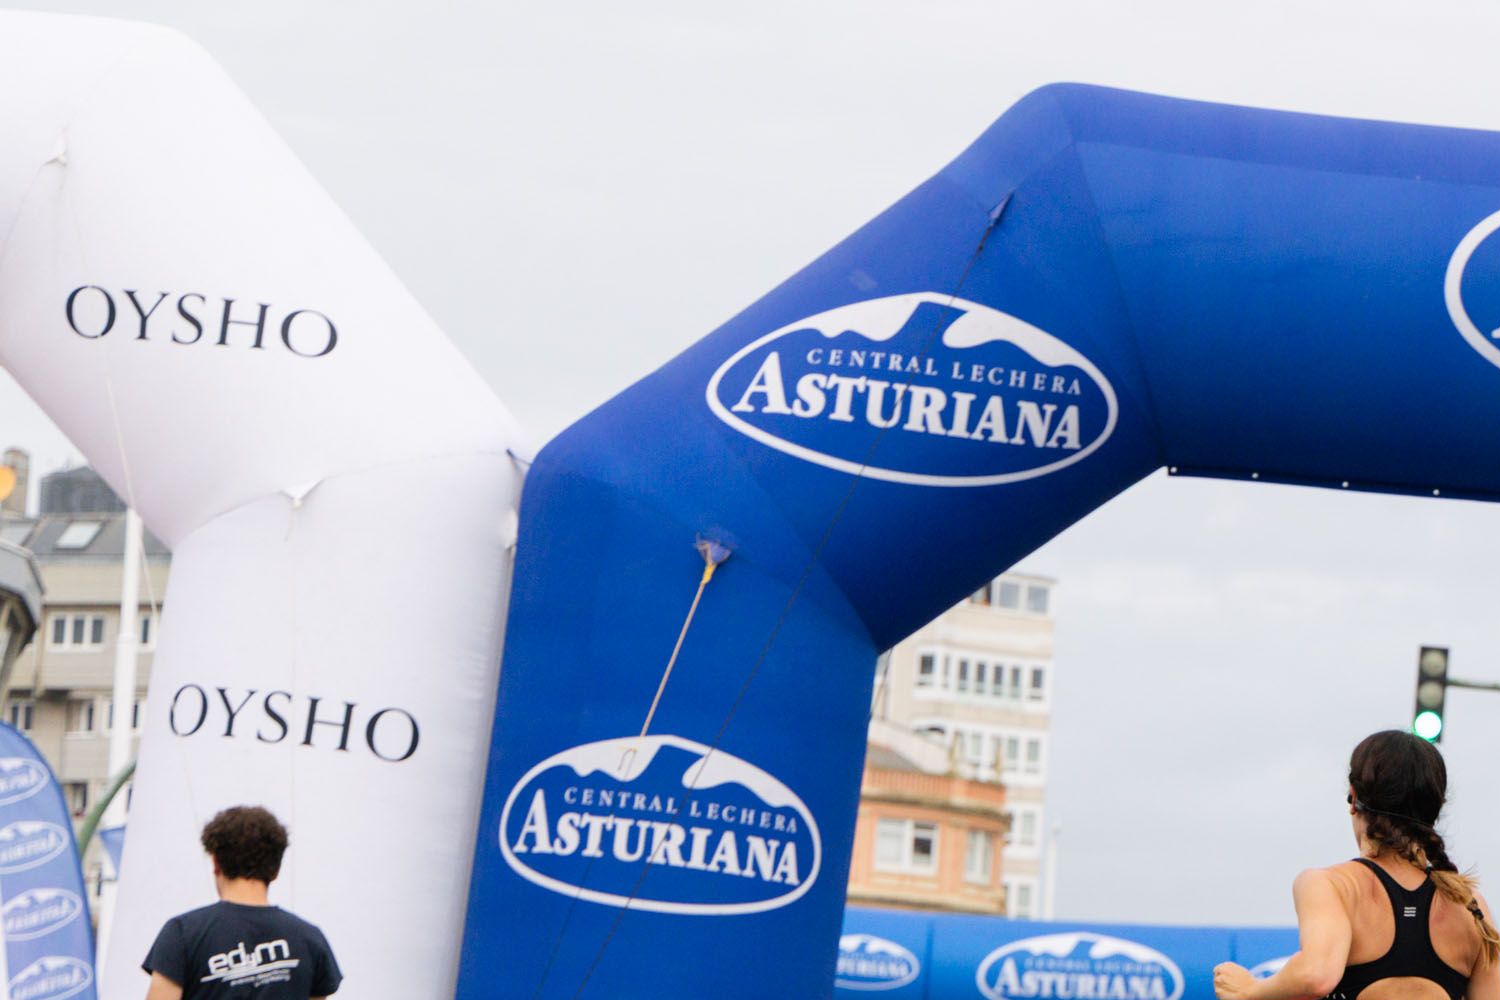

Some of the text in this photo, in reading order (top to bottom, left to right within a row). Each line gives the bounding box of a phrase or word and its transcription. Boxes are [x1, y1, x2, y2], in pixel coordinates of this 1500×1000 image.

[65, 284, 338, 358] OYSHO
[731, 350, 1082, 451] ASTURIANA
[806, 347, 1082, 396] CENTRAL LECHERA
[168, 683, 421, 763] OYSHO
[512, 788, 801, 886] ASTURIANA
[564, 786, 798, 834] CENTRAL LECHERA
